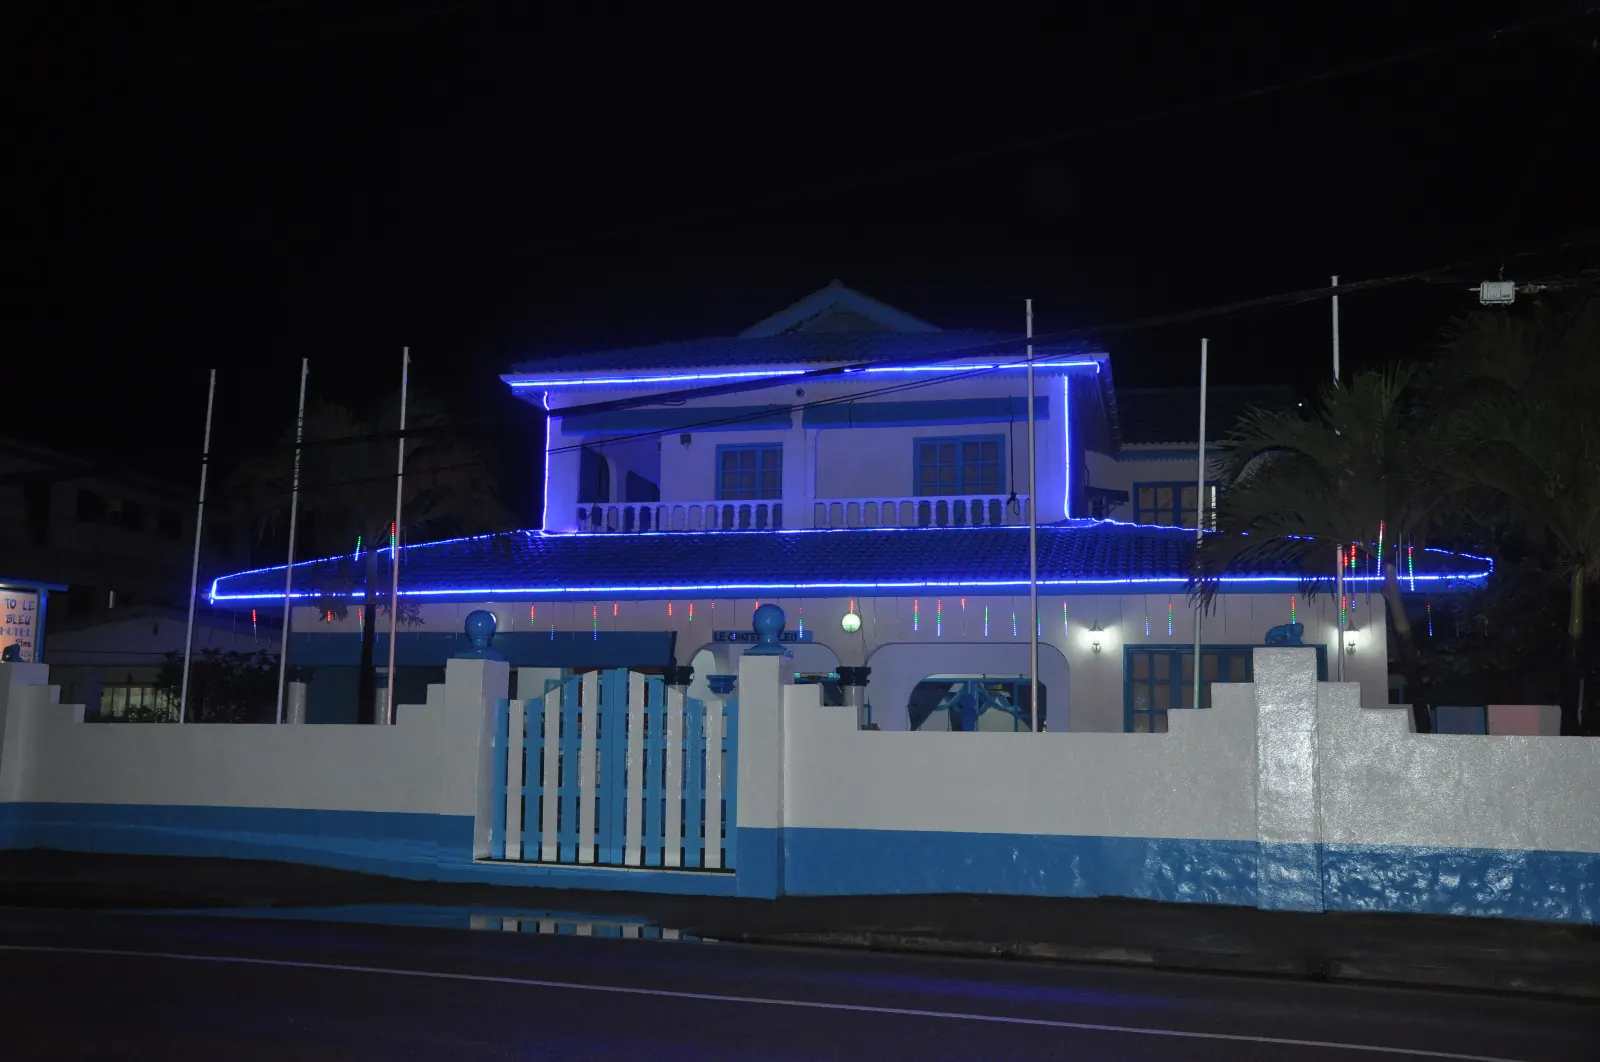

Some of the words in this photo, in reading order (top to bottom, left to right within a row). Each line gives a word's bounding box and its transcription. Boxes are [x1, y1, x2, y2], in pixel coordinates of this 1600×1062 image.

[5, 598, 16, 609] TO
[22, 600, 35, 611] LE
[6, 615, 31, 626] BLEU
[714, 631, 726, 641] LE
